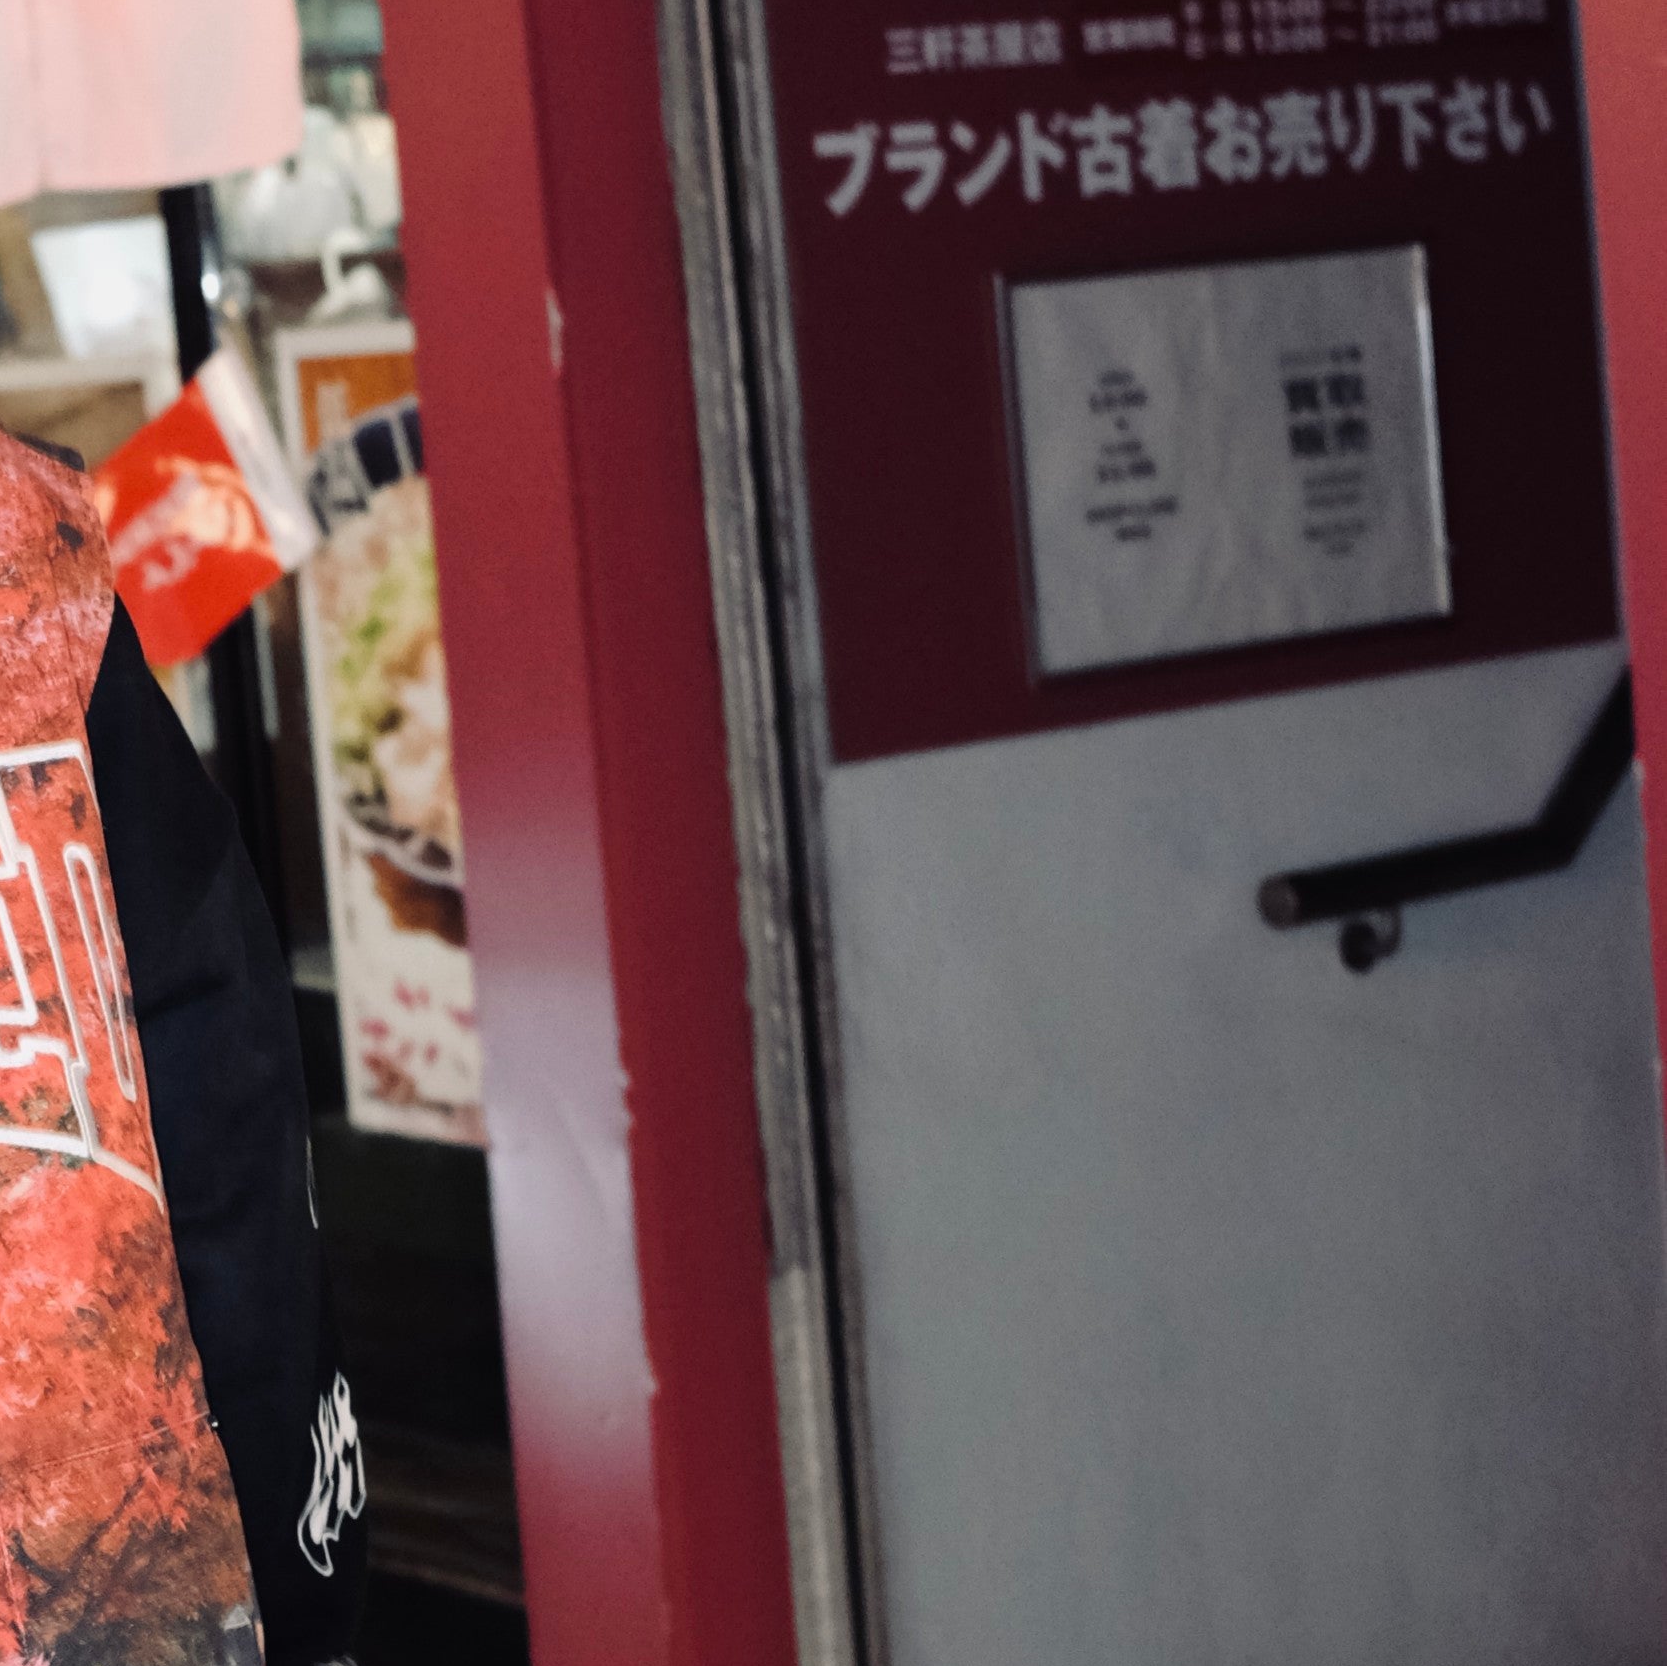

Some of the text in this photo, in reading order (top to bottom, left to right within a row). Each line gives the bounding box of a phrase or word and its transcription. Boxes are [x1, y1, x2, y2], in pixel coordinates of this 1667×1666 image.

[812, 77, 1554, 217] ブランド古着お売り下さい
